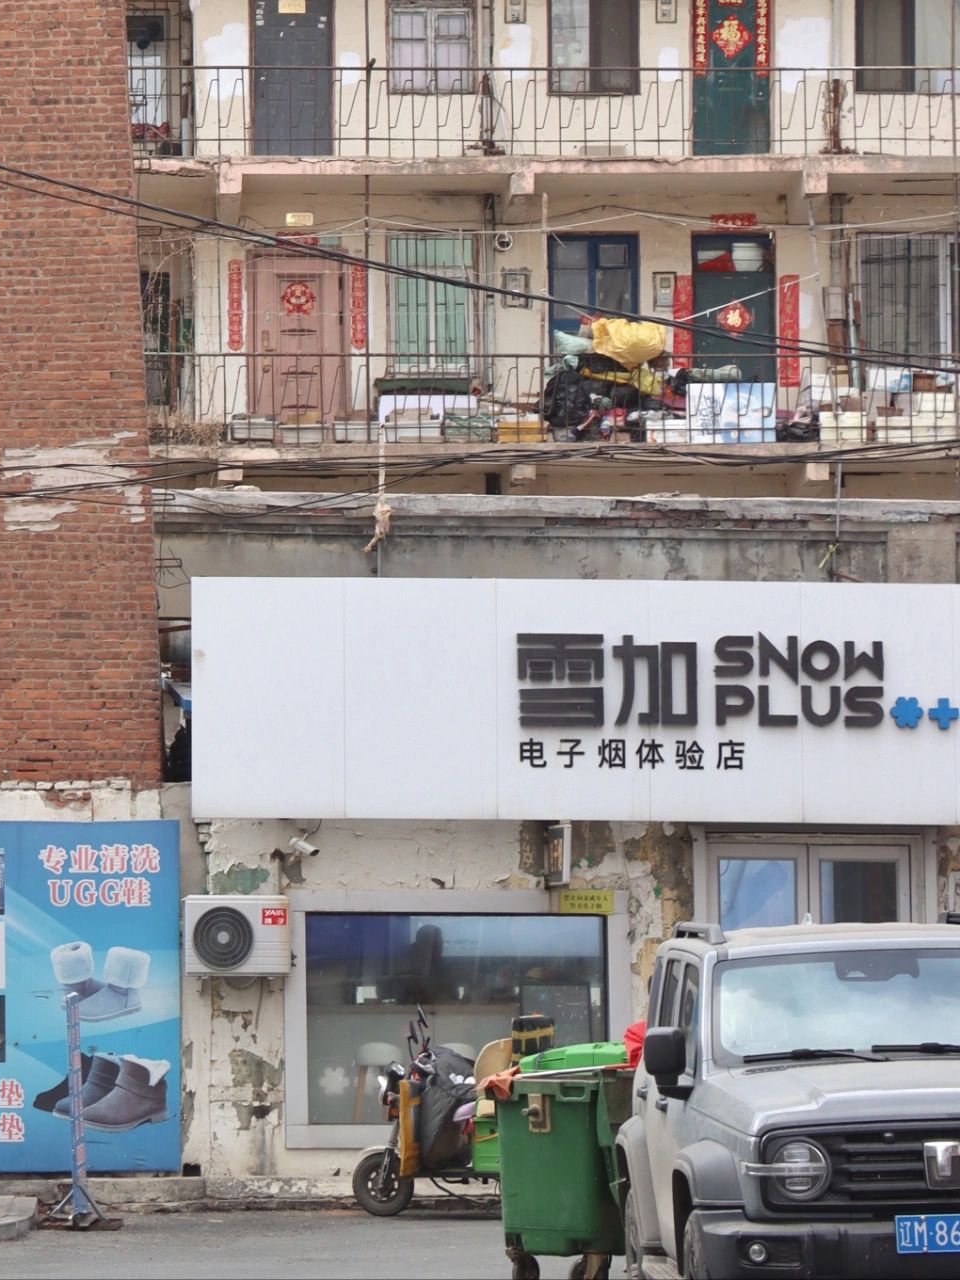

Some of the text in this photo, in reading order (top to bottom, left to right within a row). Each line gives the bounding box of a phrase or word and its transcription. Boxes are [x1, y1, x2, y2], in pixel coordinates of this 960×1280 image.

[720, 20, 742, 42] 福
[726, 309, 743, 327] 福
[714, 631, 885, 684] SNOW
[516, 632, 698, 728] 雪加
[714, 684, 885, 727] PLUS
[518, 737, 746, 771] 电子烟体验店
[38, 843, 161, 875] 专业清洗
